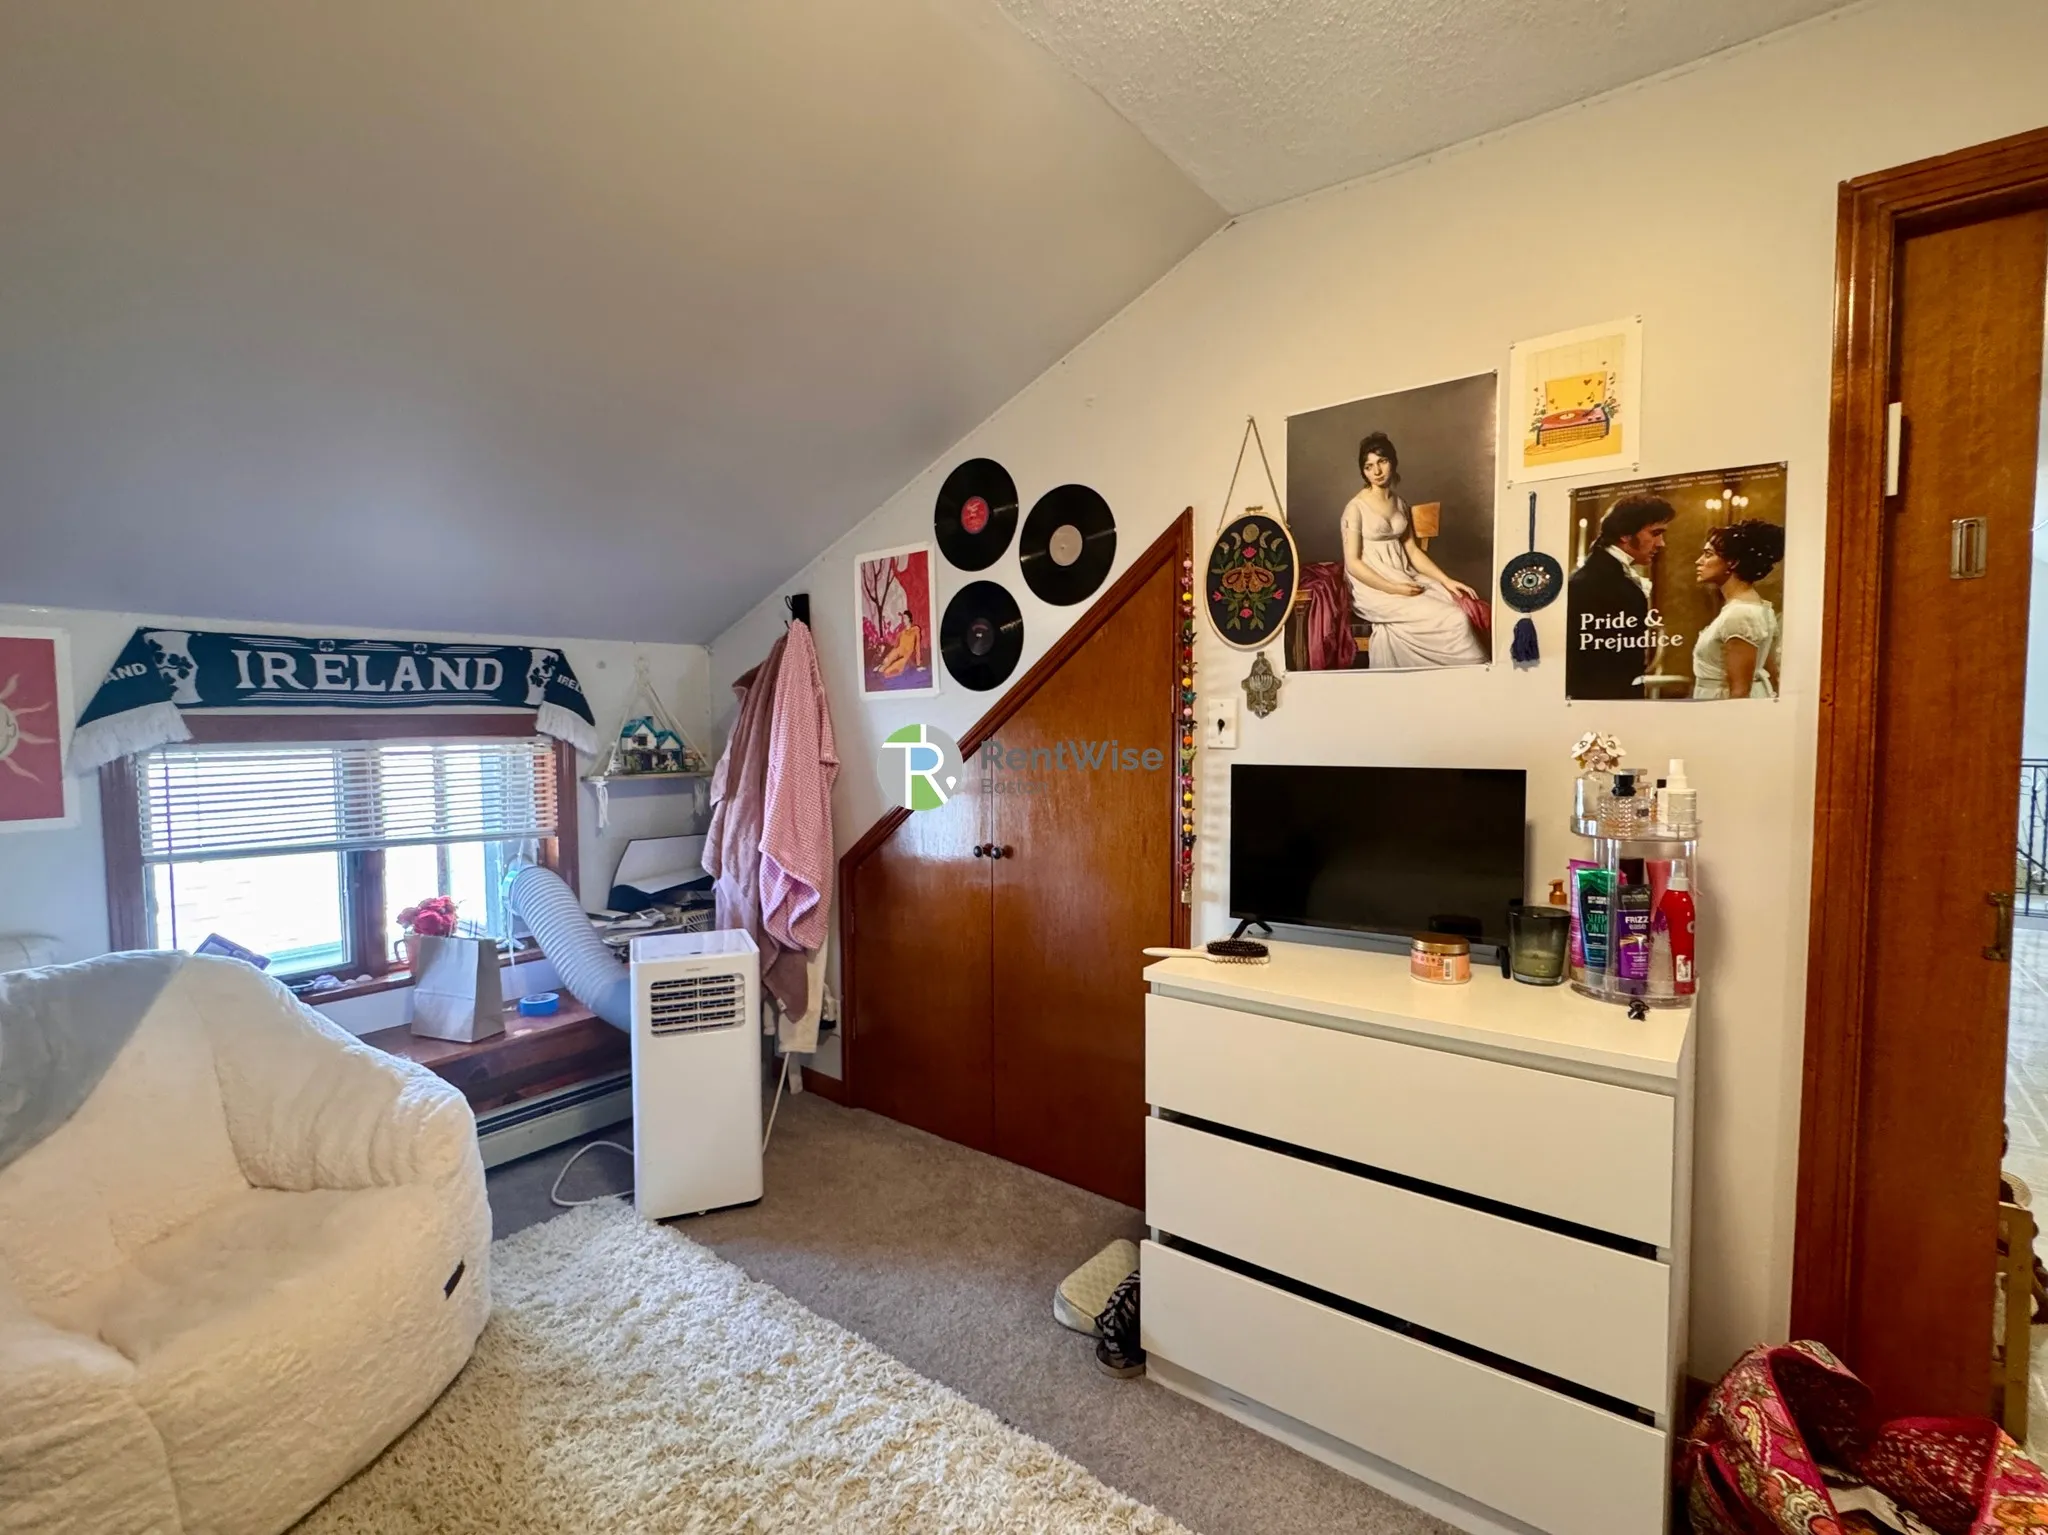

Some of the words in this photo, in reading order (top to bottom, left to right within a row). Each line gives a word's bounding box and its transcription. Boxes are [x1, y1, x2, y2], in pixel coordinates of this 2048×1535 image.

[1580, 611, 1638, 630] Pride
[1644, 608, 1664, 627] &
[1579, 630, 1683, 652] Prejudice
[230, 649, 504, 692] IRELAND
[1625, 916, 1649, 924] FRIZZ
